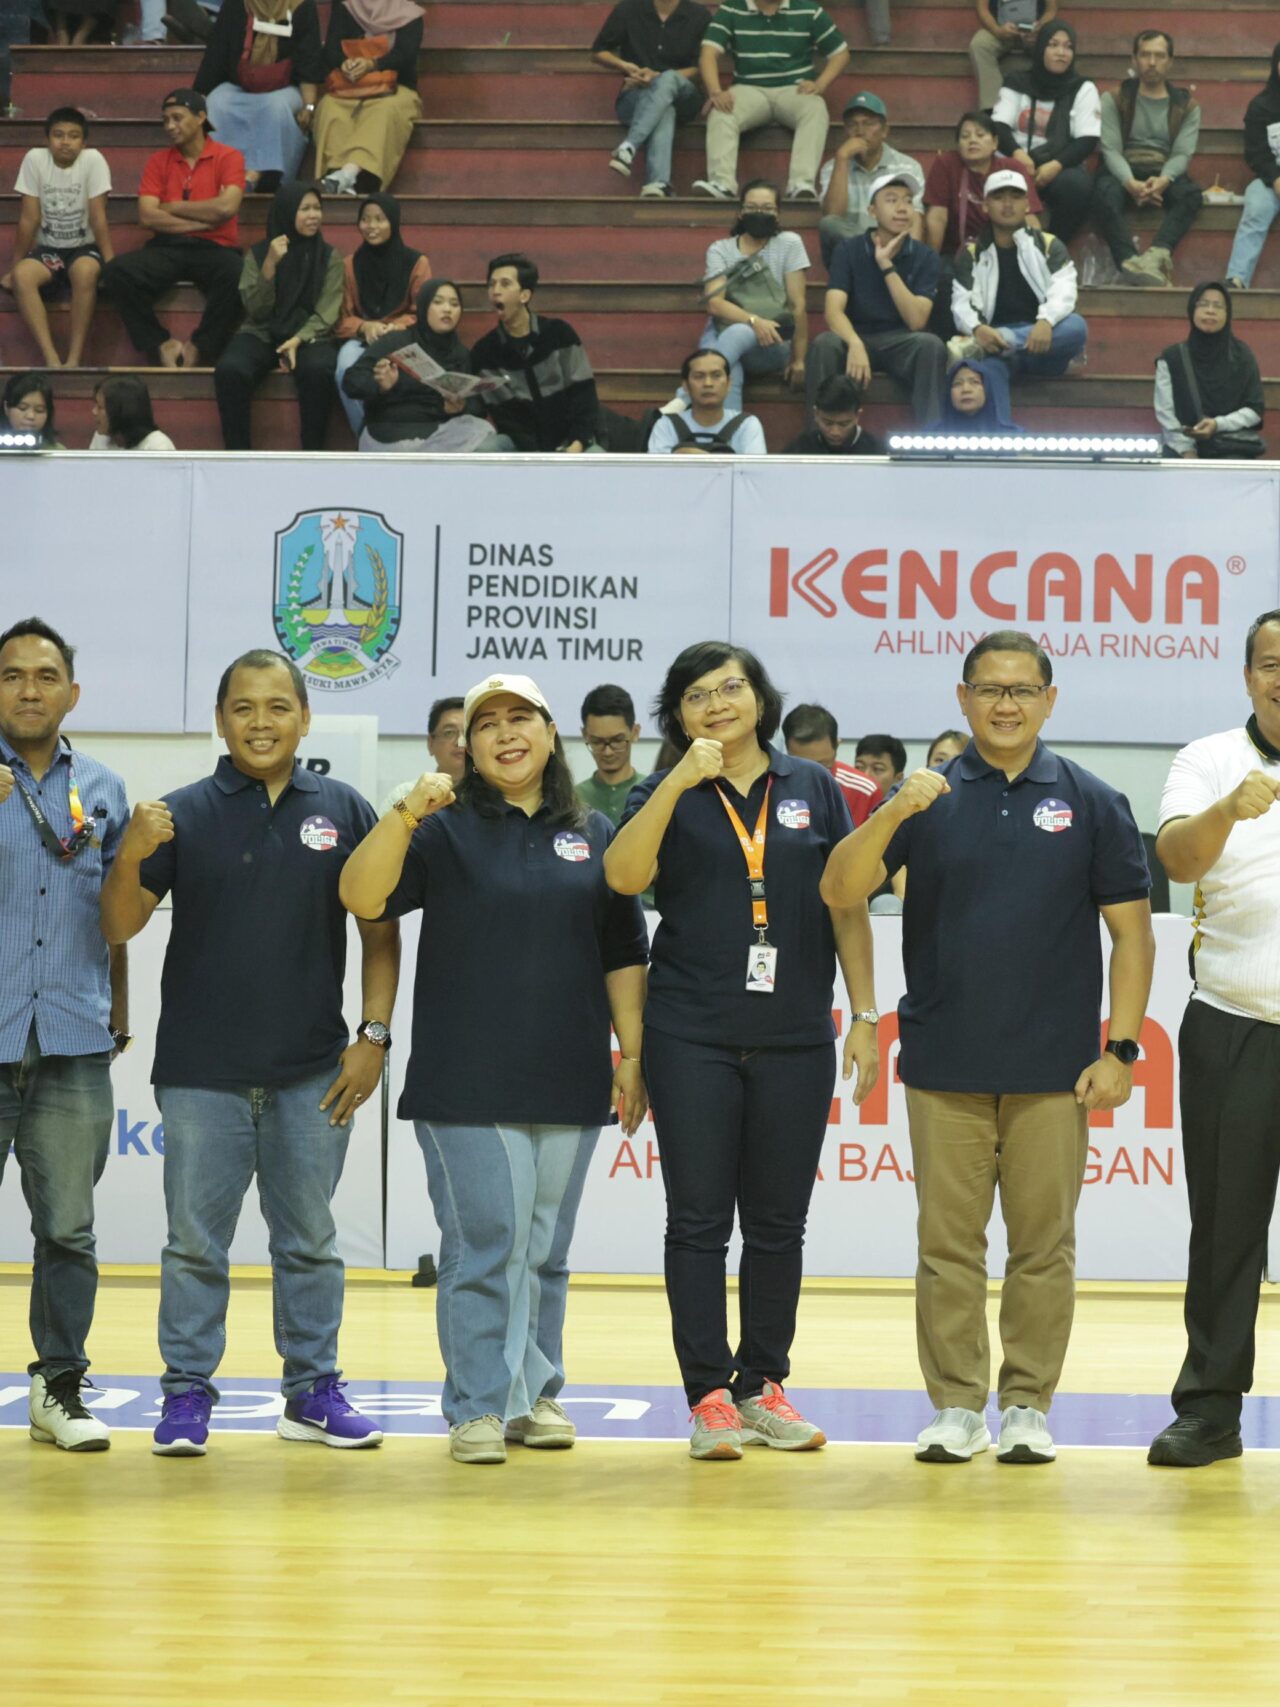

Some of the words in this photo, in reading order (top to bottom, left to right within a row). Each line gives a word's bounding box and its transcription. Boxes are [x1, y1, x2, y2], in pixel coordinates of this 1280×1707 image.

[469, 543, 554, 567] DINAS
[468, 574, 638, 599] PENDIDIKAN
[769, 547, 1220, 626] KENCANA
[467, 605, 597, 629] PROVINSI
[466, 636, 548, 660] JAWA
[557, 637, 643, 661] TIMUR
[874, 630, 988, 655] AHLINY
[1037, 632, 1092, 658] AJA
[1100, 633, 1220, 659] RINGAN
[334, 676, 367, 690] MAWA
